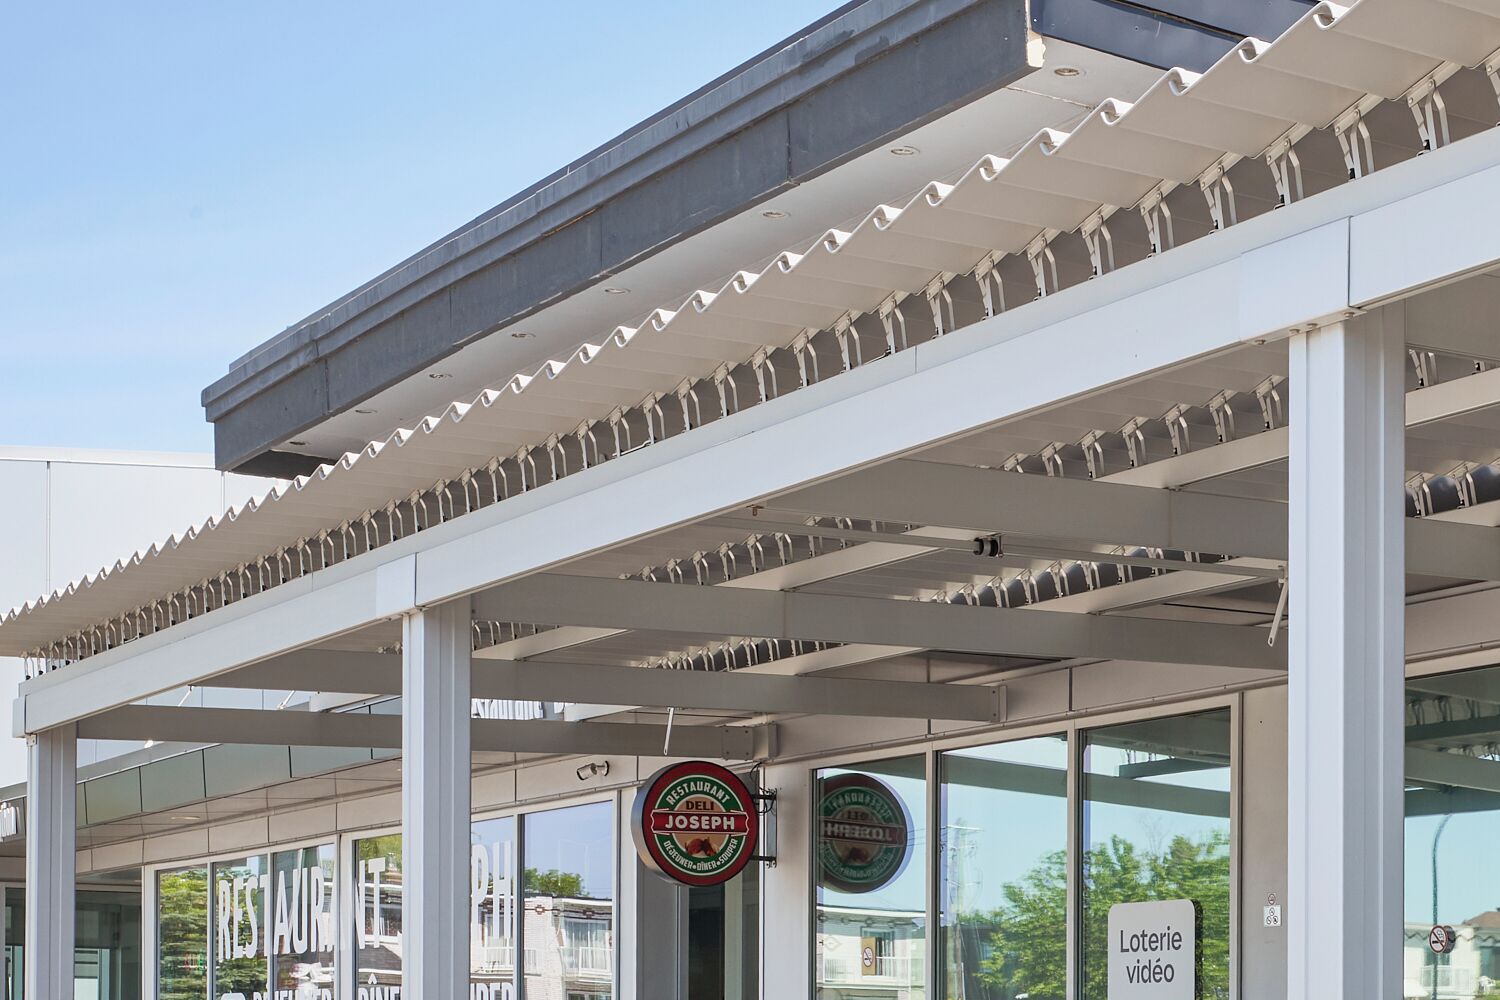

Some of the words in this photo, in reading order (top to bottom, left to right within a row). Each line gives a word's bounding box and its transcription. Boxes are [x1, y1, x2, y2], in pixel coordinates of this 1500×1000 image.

[666, 781, 730, 805] RESTAURANT
[685, 800, 714, 811] DELI
[665, 815, 735, 830] JOSEPH
[663, 840, 693, 869] DÉJEUNER
[696, 861, 717, 871] DÎNER
[719, 838, 738, 864] SOUPER
[1120, 925, 1182, 953] Loterie
[1126, 957, 1175, 984] vidéo
